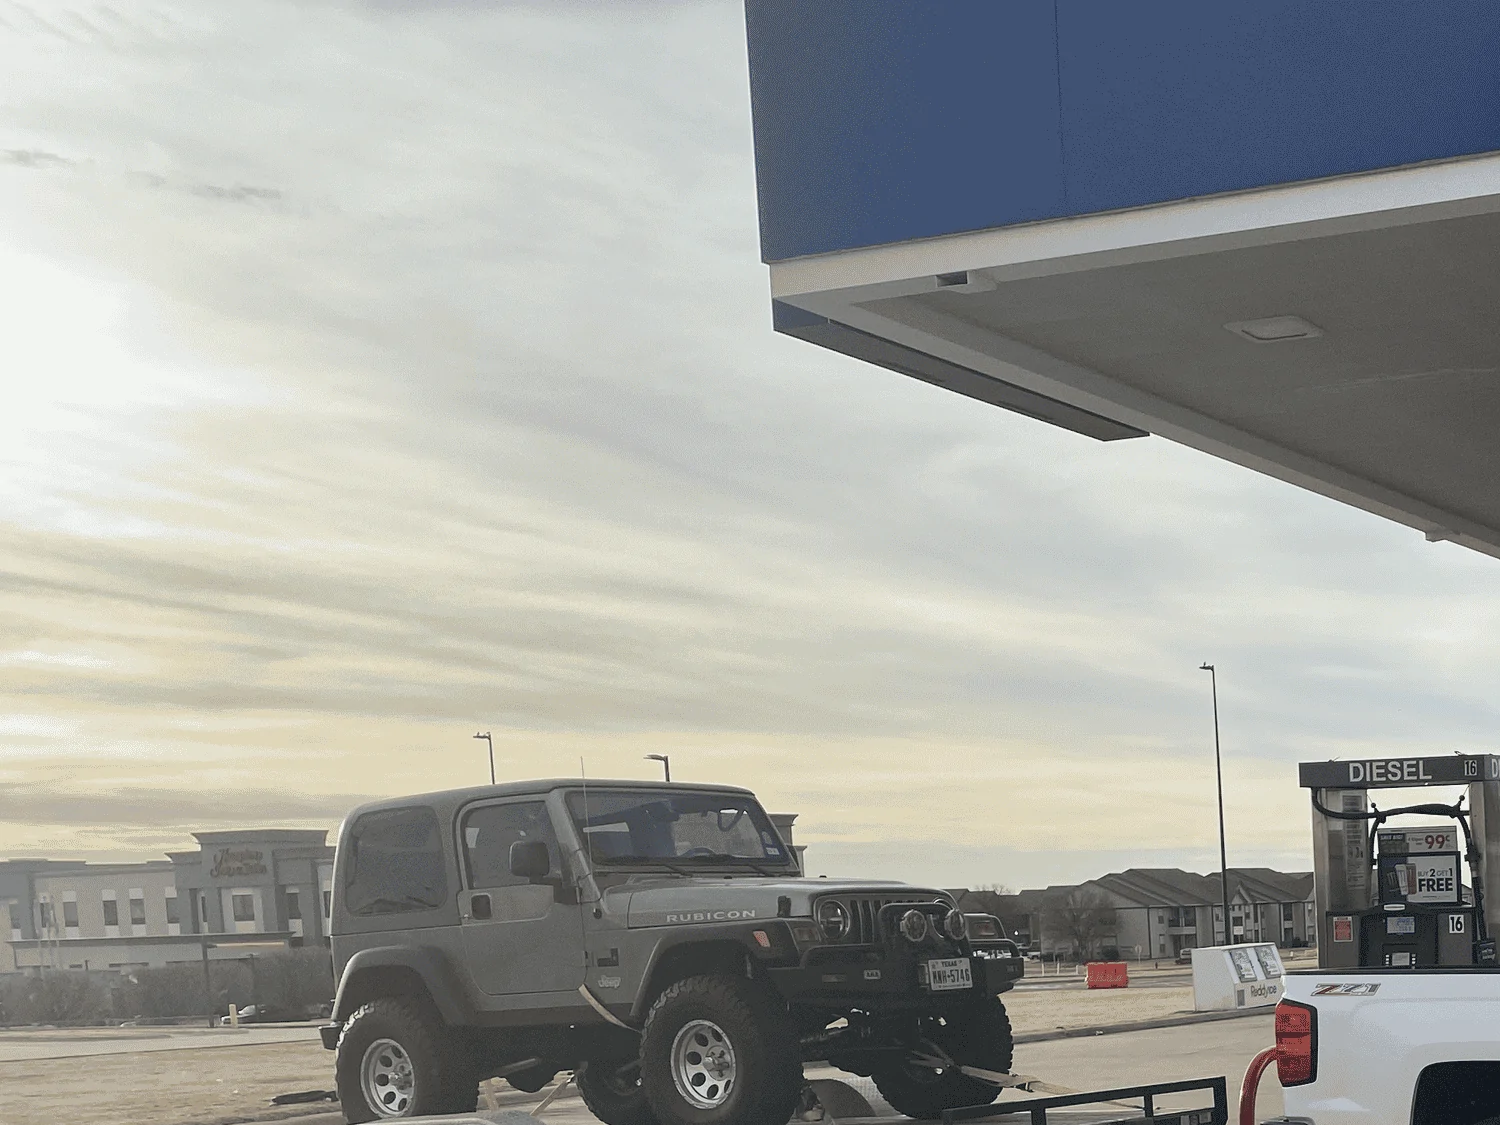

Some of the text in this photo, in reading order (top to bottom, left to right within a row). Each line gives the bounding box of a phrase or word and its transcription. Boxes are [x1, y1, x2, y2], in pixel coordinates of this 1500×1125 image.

[1349, 760, 1433, 783] DIESEL
[1464, 760, 1477, 776] 16
[1417, 868, 1453, 878] BUY 2 GET 1
[1418, 878, 1454, 892] FREE
[666, 910, 756, 923] RUBICON
[1450, 916, 1464, 932] 16
[941, 960, 958, 968] TEXAS
[1310, 982, 1382, 997] Z71
